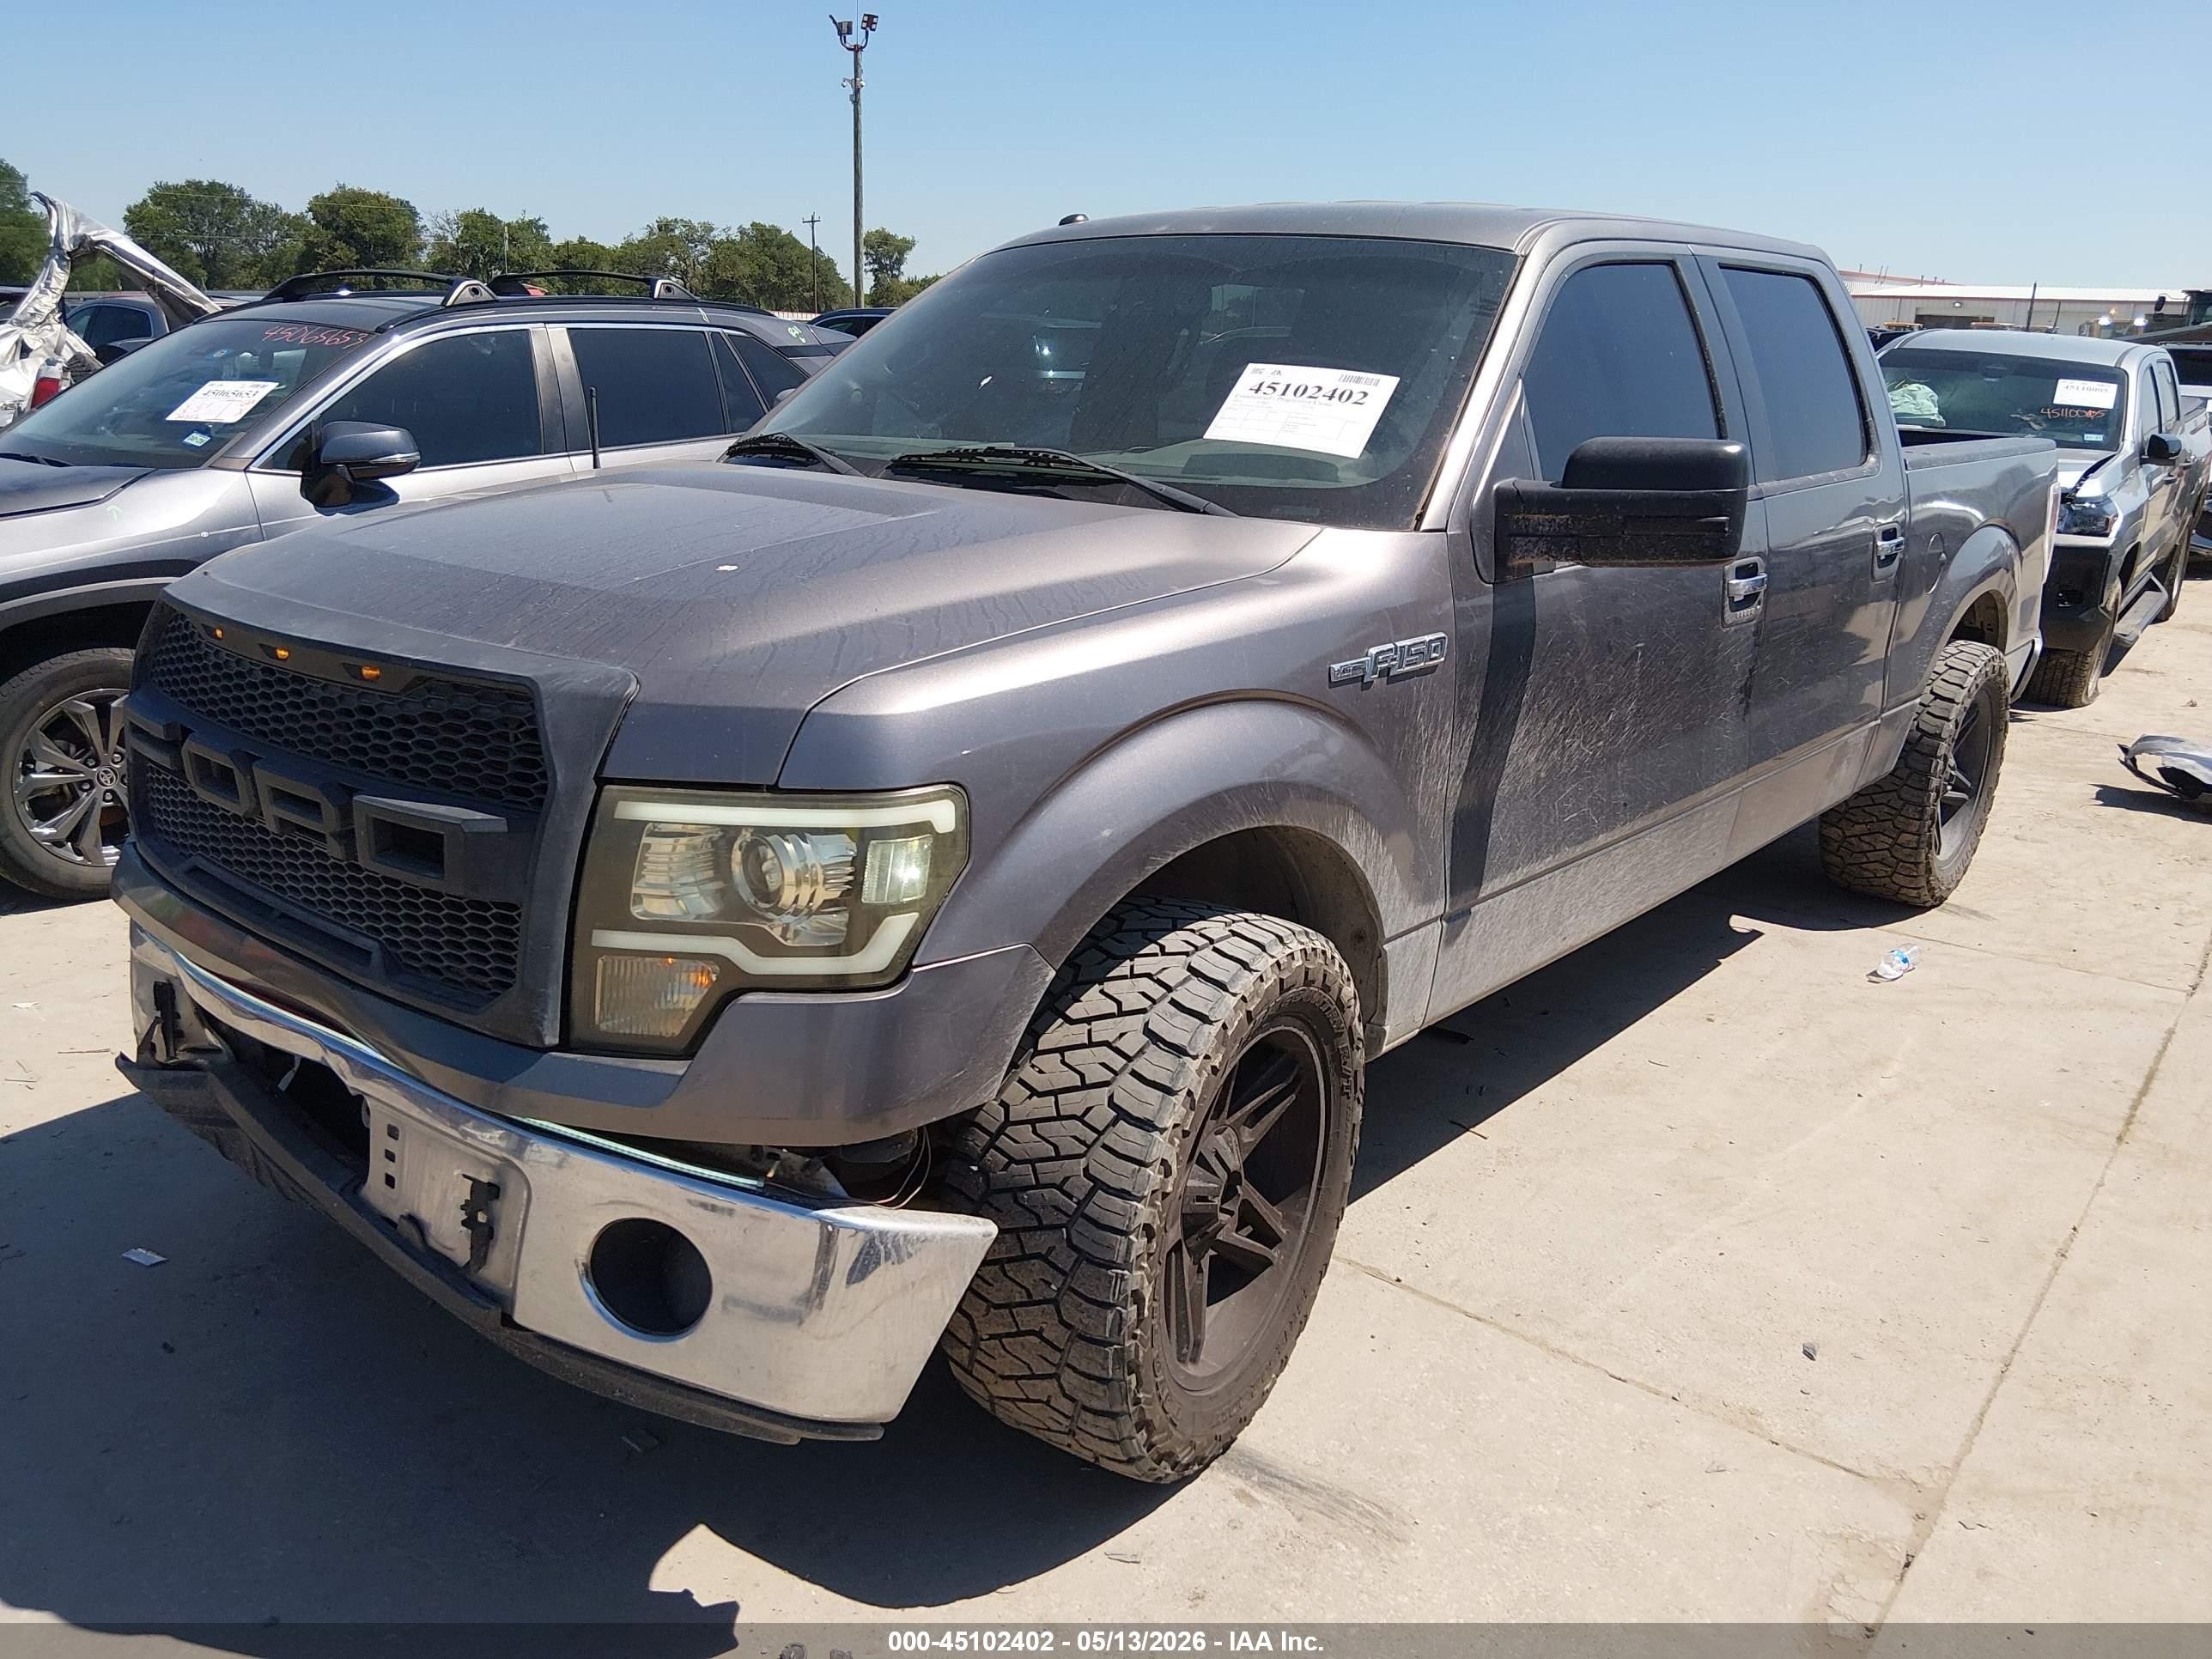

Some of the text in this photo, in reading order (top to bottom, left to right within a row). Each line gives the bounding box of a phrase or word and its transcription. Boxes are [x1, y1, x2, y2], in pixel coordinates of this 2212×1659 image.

[262, 325, 368, 349] 45065653
[1248, 380, 1370, 406] 45102402
[125, 711, 508, 902] FORD
